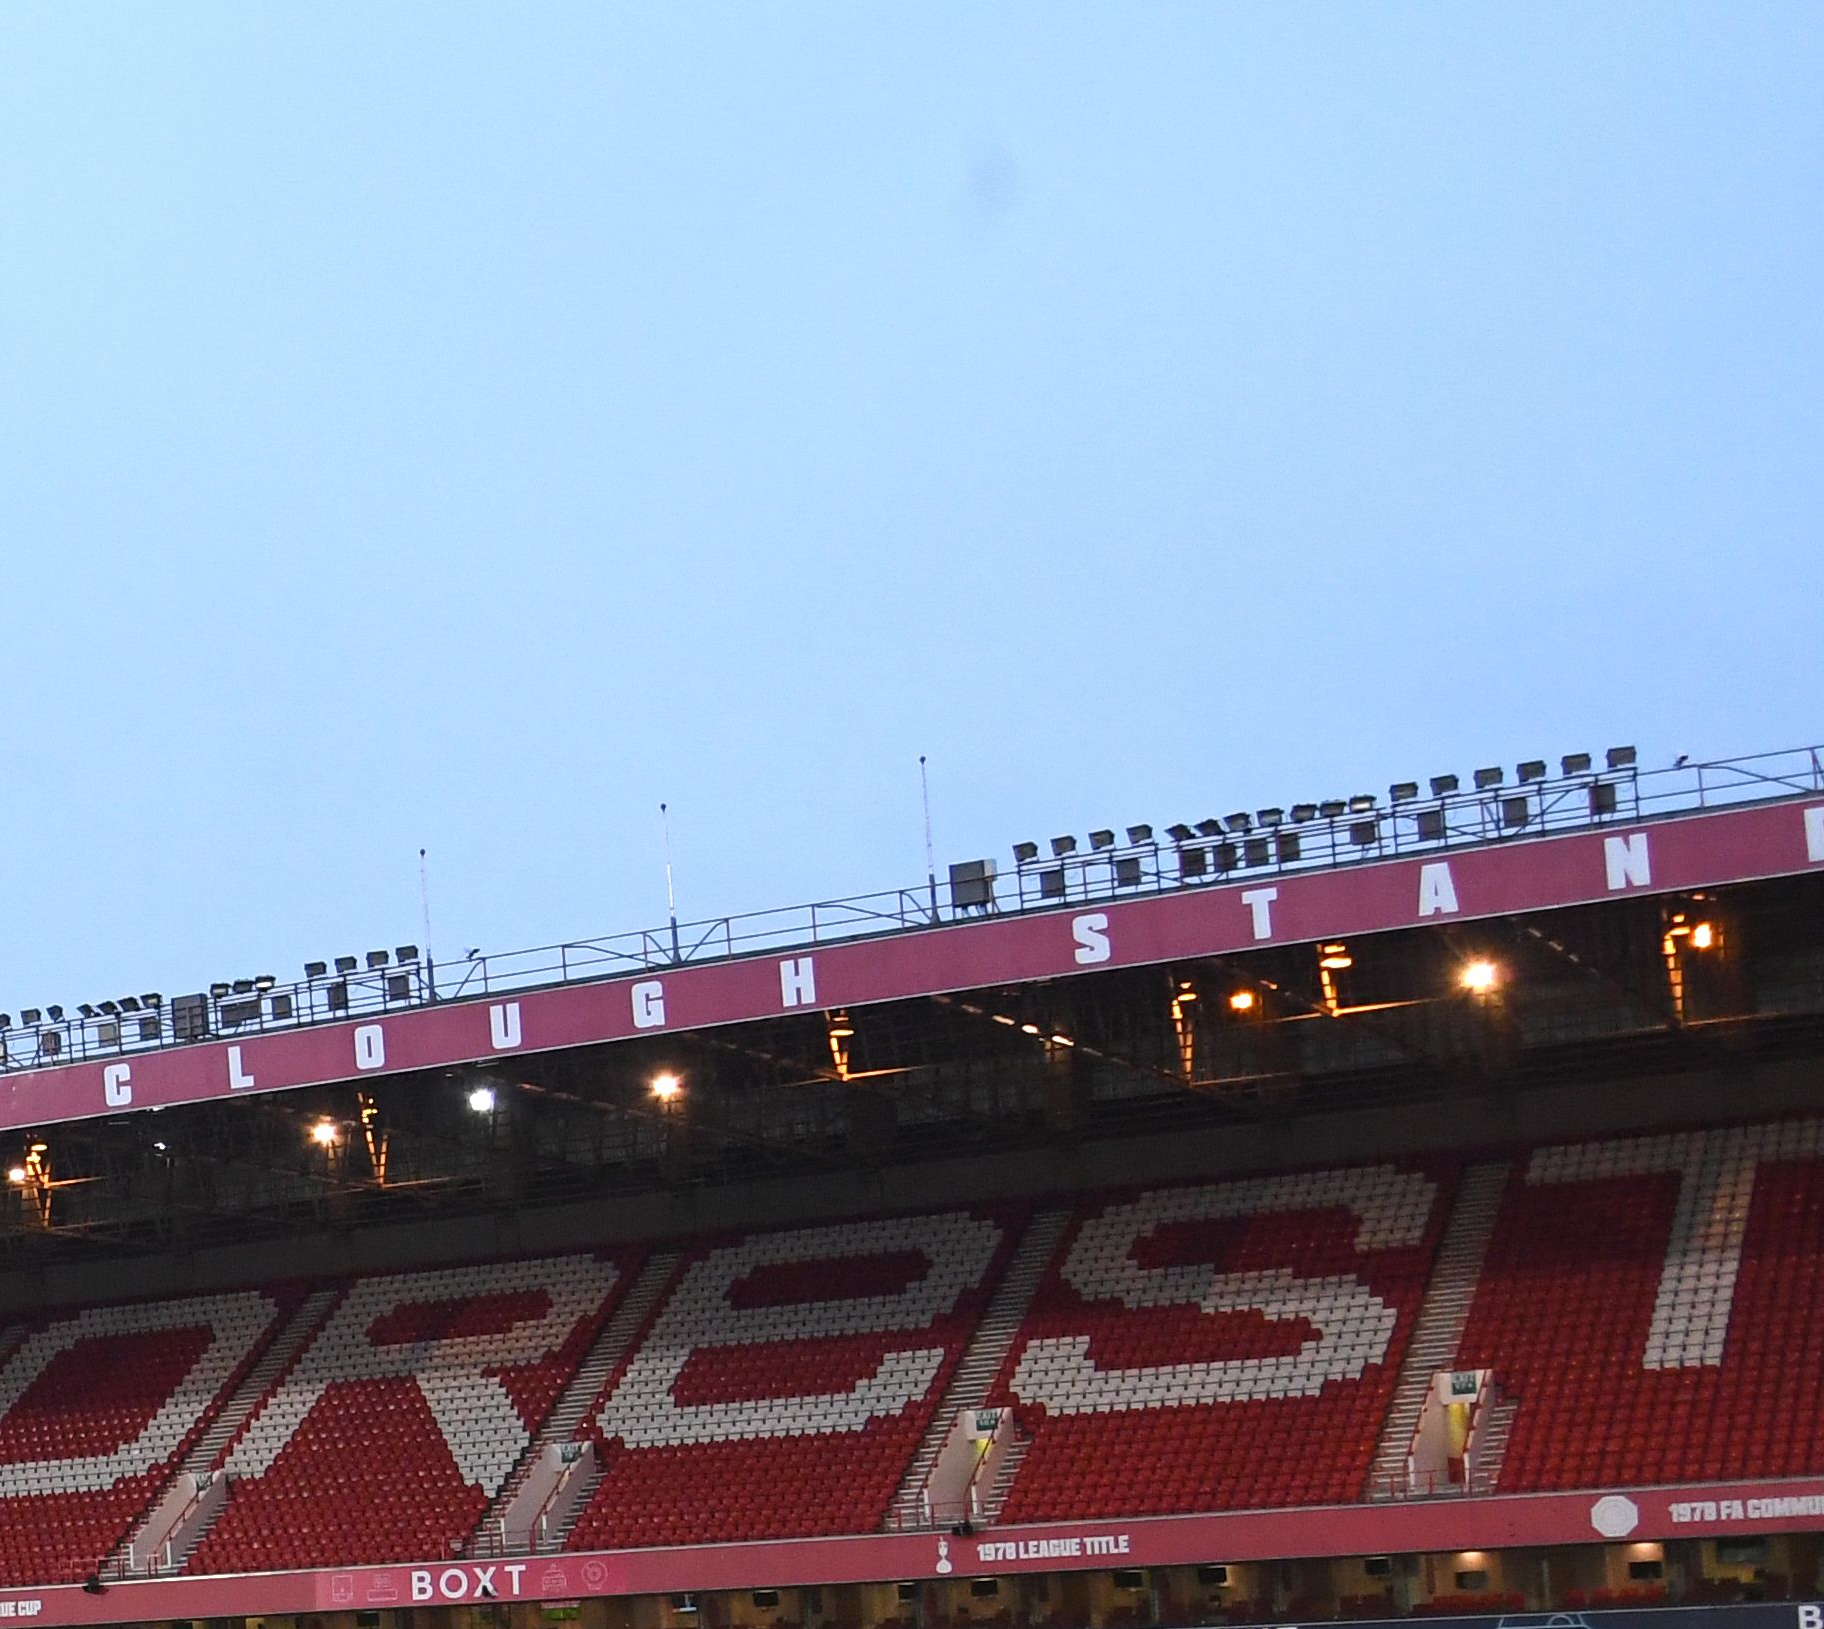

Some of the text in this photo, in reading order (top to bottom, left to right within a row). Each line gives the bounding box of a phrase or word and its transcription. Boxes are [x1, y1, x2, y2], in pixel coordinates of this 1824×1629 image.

[104, 957, 817, 1107] CLOUGH
[1668, 1502, 1718, 1522] 1978
[1721, 1501, 1745, 1520] FA
[977, 1536, 1130, 1562] 1978 LEAGUE TITLE
[411, 1564, 526, 1601] BOXT
[18, 1601, 41, 1617] CUP
